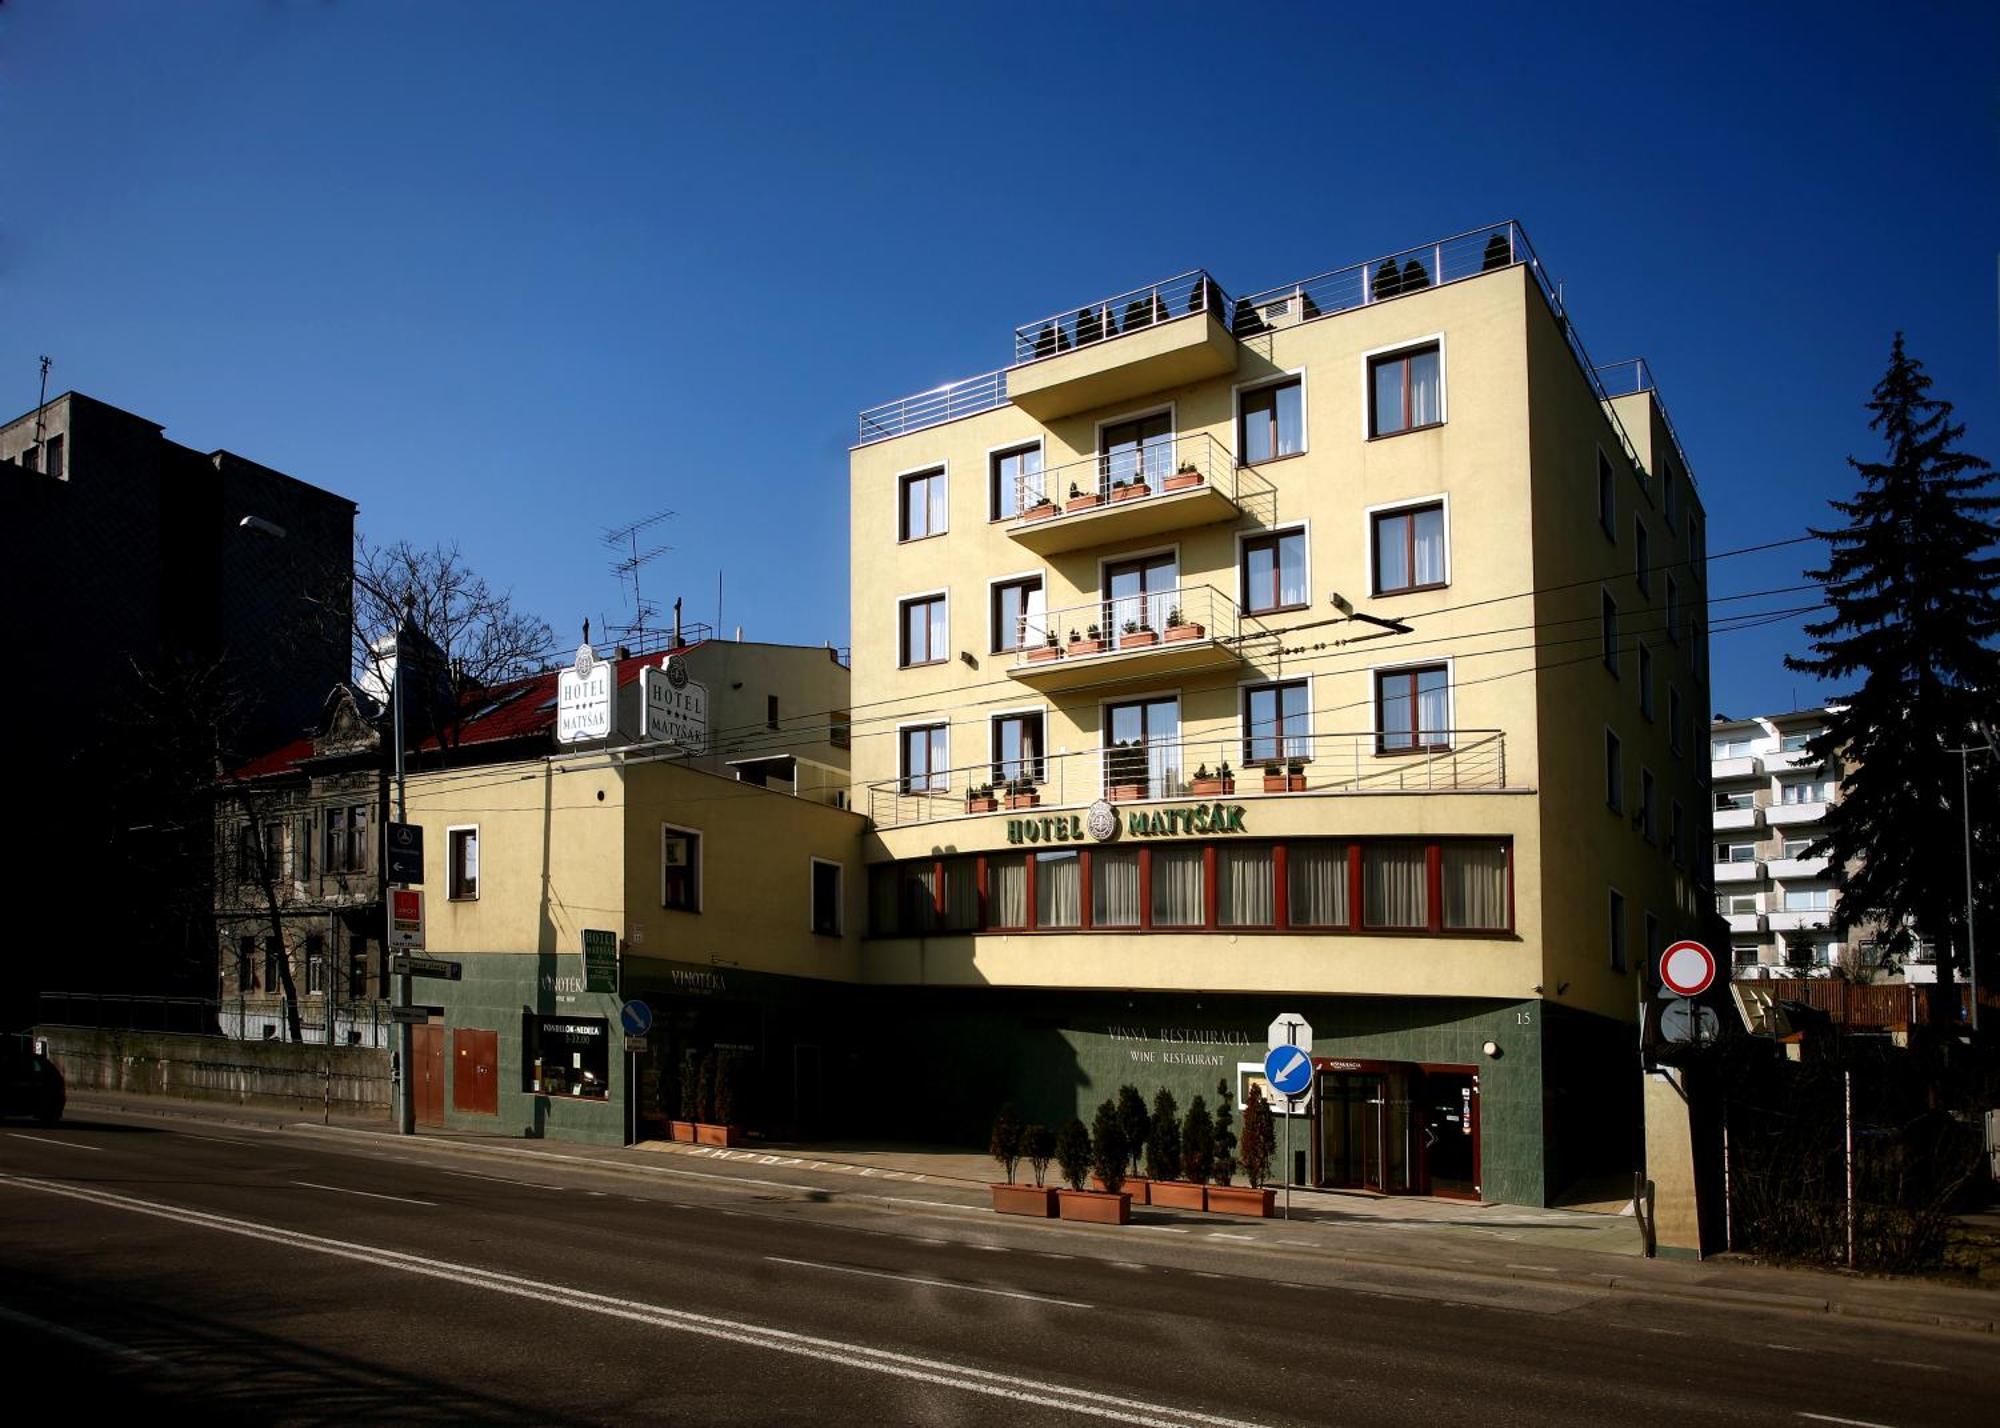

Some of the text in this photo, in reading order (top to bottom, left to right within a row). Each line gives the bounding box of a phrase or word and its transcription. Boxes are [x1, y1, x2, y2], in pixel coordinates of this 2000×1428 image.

[564, 679, 605, 701] HOTEL
[653, 685, 701, 713] HOTEL
[1007, 816, 1083, 843] HOTEL
[586, 931, 615, 945] HOTEL
[1516, 1012, 1531, 1025] 15
[1130, 1050, 1224, 1066] WINE RESTAURANT
